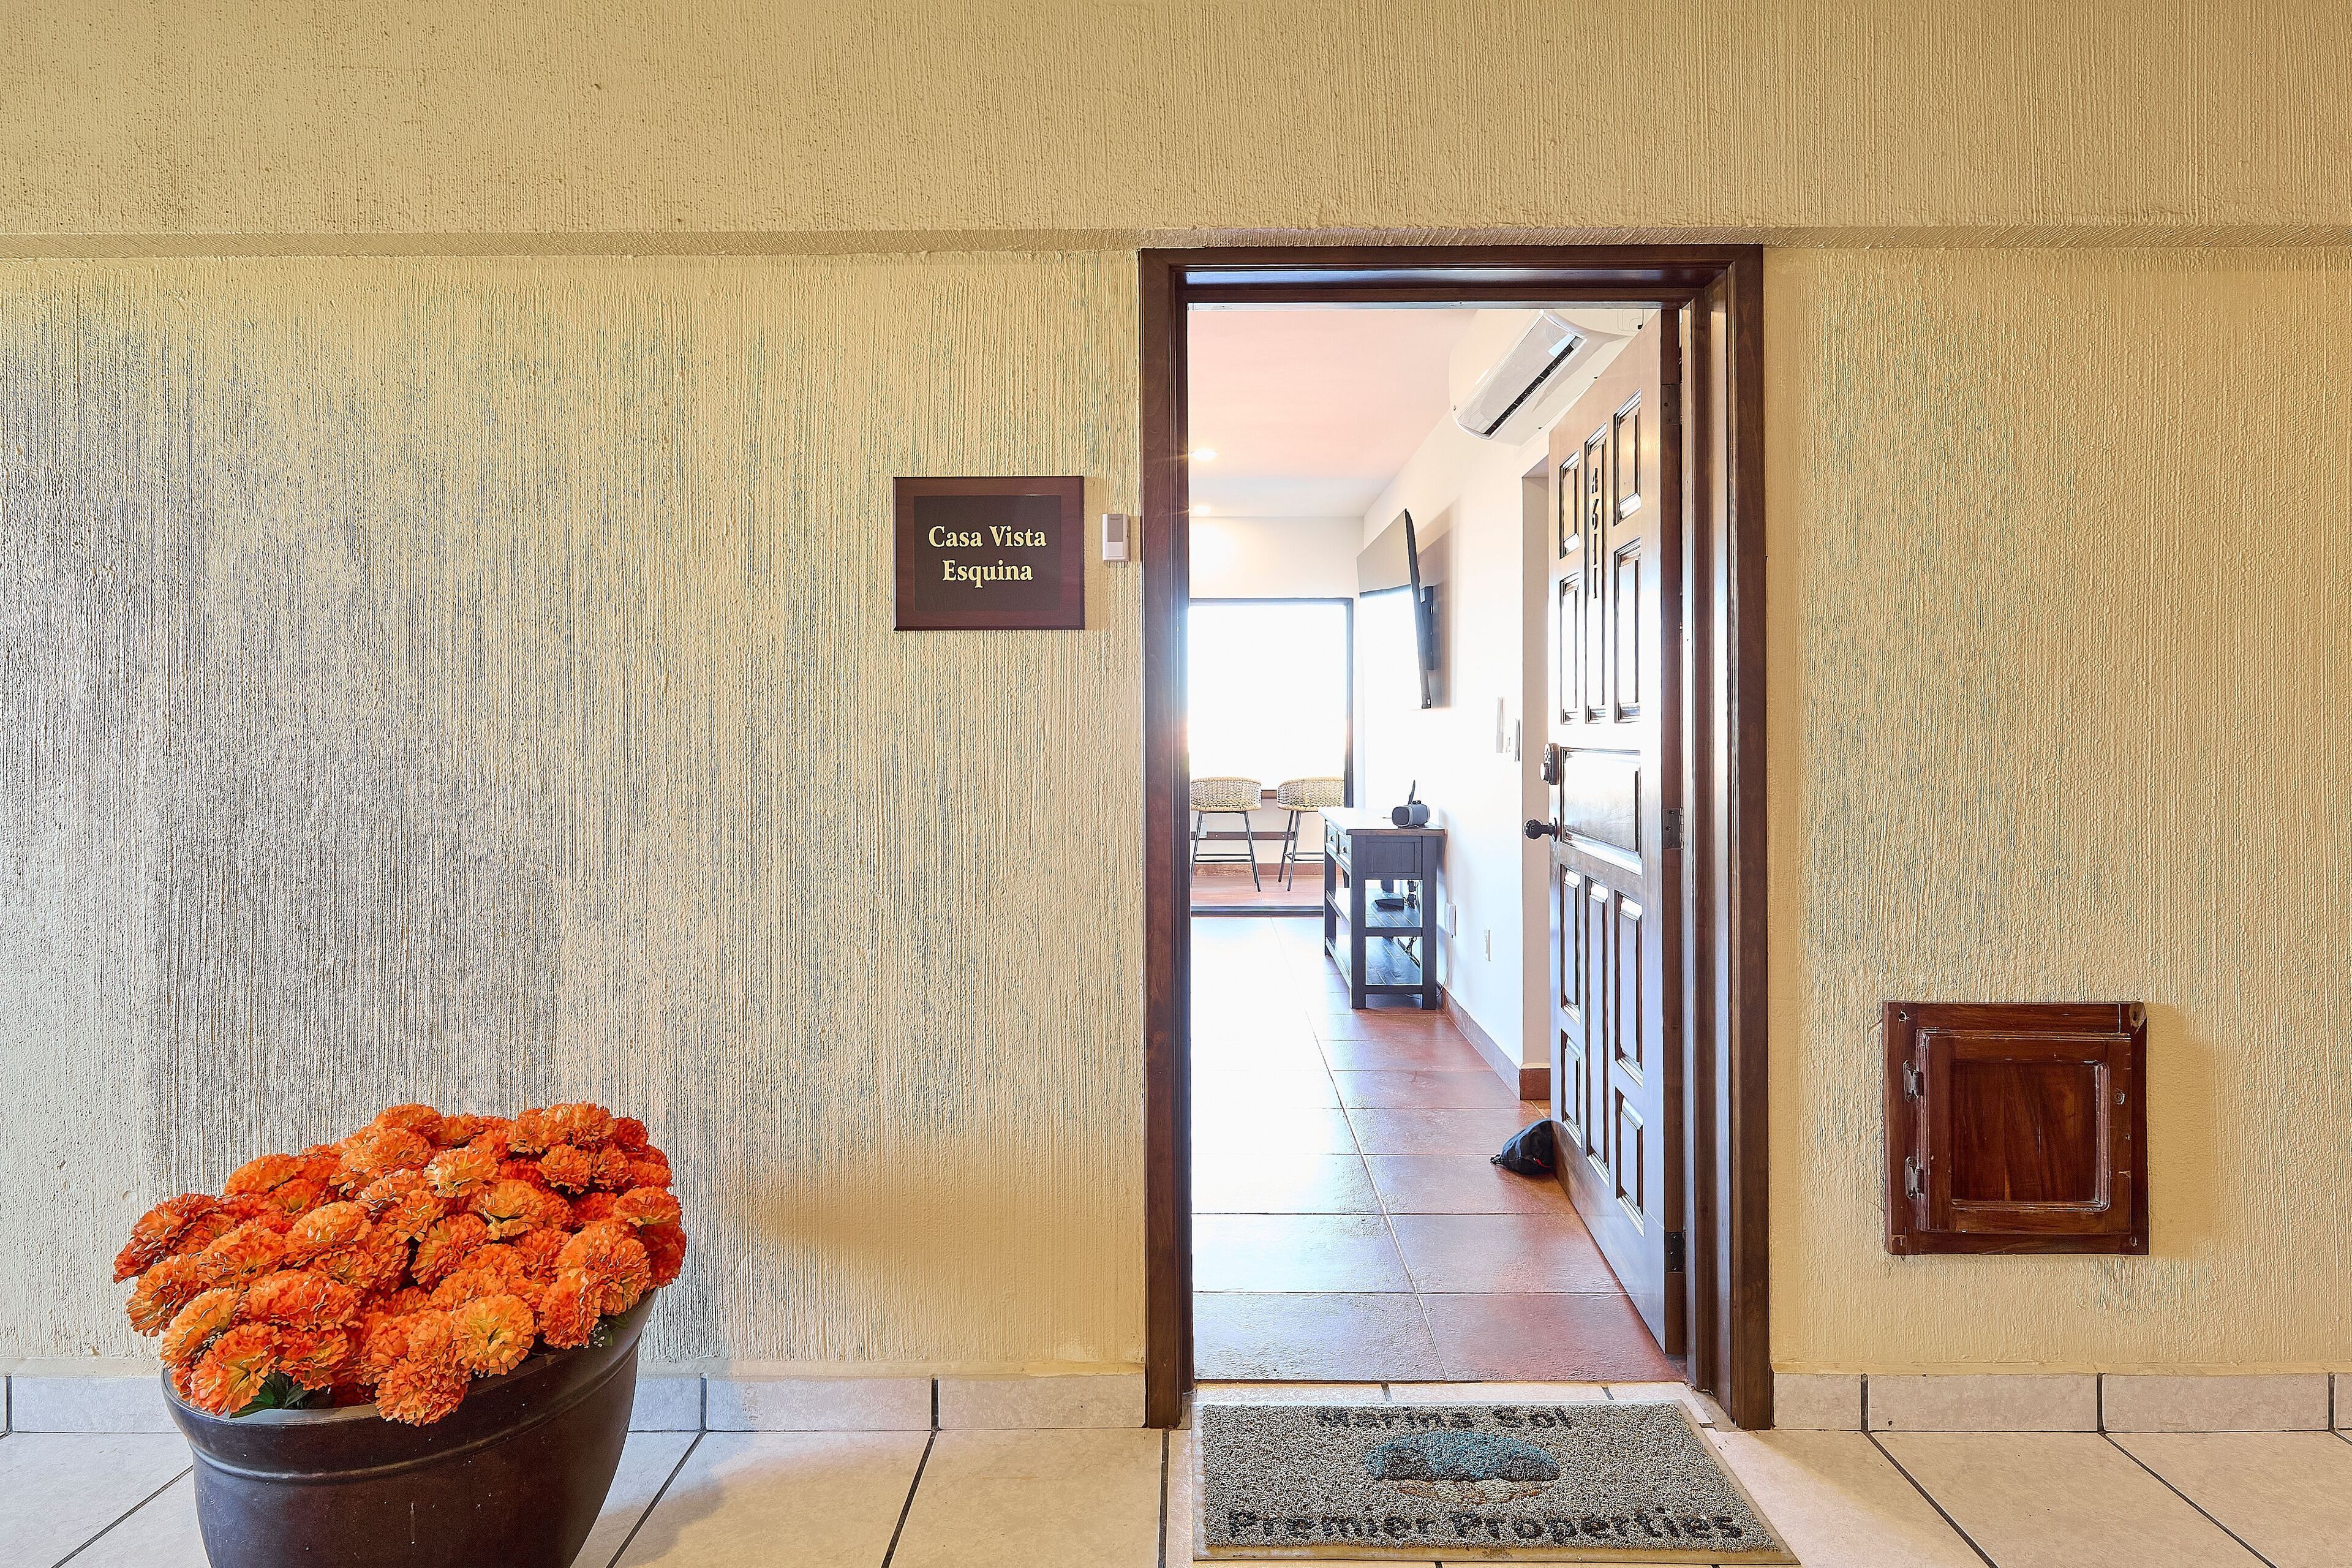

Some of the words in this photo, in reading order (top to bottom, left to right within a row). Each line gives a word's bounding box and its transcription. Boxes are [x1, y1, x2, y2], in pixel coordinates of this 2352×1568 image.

[928, 525, 983, 548] Casa
[989, 525, 1047, 548] Vista
[941, 559, 1034, 589] Esquina
[1493, 1407, 1572, 1430] Sol
[1227, 1506, 1434, 1540] Premier
[1451, 1506, 1743, 1545] Properties
